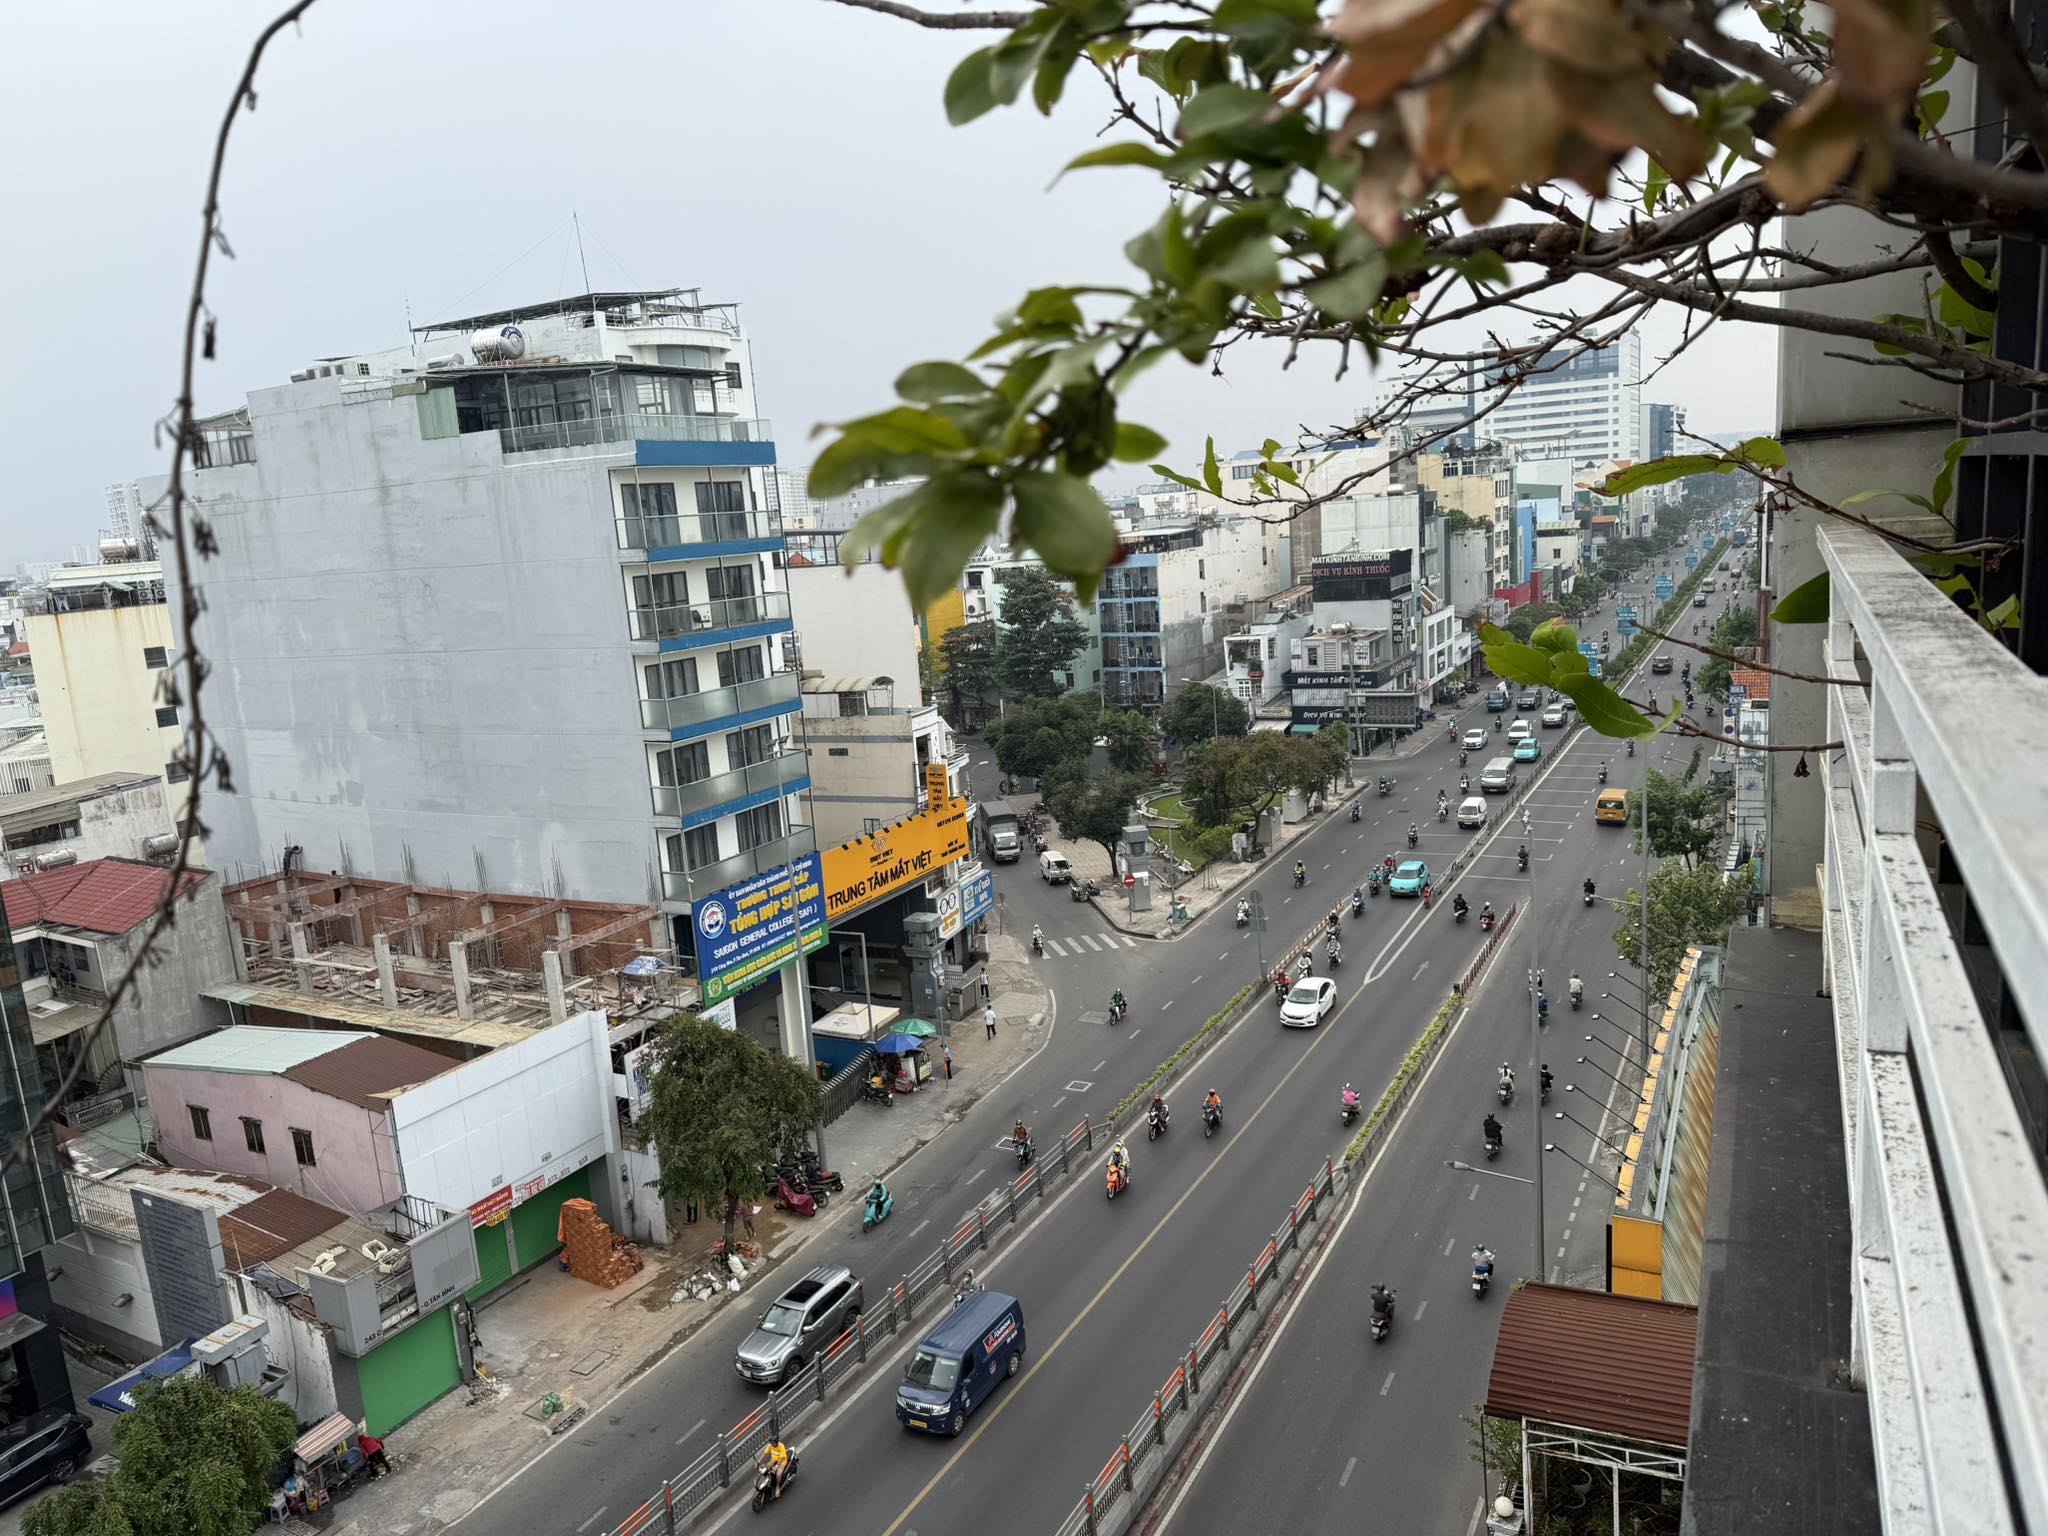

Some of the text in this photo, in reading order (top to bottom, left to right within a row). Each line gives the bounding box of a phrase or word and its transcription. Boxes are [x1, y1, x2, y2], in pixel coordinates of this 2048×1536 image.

[1343, 565, 1363, 575] KÍNH
[1366, 562, 1391, 574] THUỐC
[828, 881, 866, 910] TRUNG
[867, 871, 889, 891] TÂM
[890, 858, 911, 880] MẮT
[911, 850, 932, 871] VIỆT
[729, 911, 759, 934] TỔNG
[759, 900, 781, 921] HỢP
[799, 883, 820, 903] GÒN
[713, 941, 739, 959] SAIGON
[740, 927, 769, 947] GENERAL
[768, 914, 795, 933] COLLEGE
[441, 1284, 455, 1297] BÌNH
[364, 1333, 376, 1344] 243
